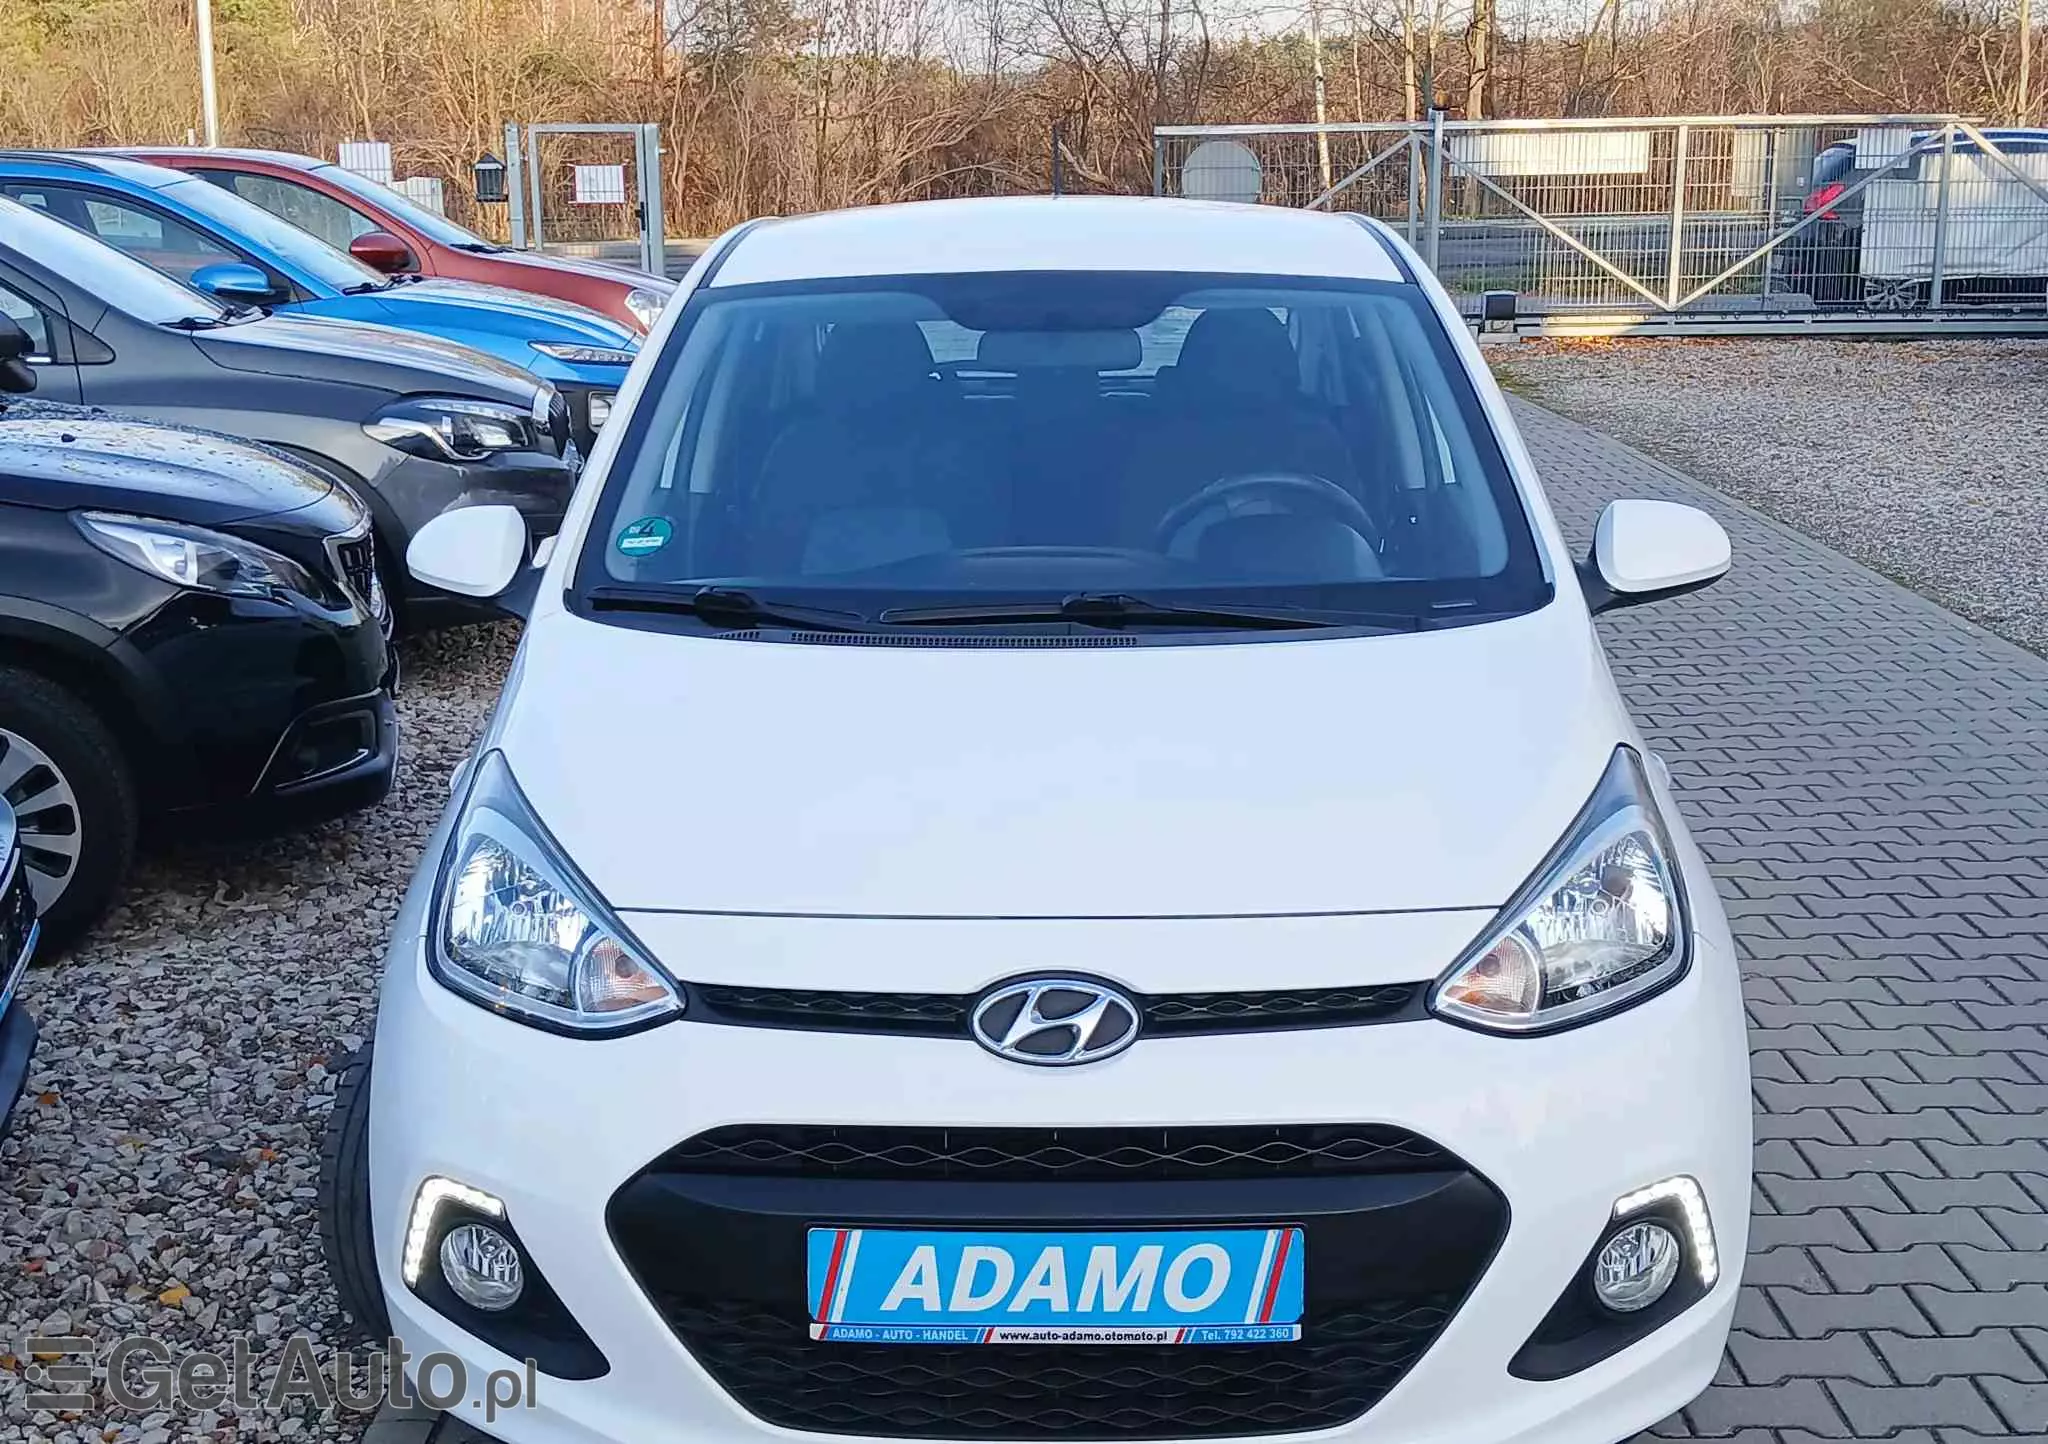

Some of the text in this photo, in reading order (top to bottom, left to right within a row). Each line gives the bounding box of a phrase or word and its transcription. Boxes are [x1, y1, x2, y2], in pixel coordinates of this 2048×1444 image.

[879, 1243, 1231, 1313] ADAMO
[832, 1327, 873, 1340] ADAMO
[882, 1328, 913, 1340] AUTO
[922, 1328, 969, 1341] HANDEL
[1000, 1330, 1168, 1342] www.auto-adamo.otomoto.pl
[1201, 1330, 1220, 1341] Tel.
[1224, 1329, 1245, 1340] 792
[1246, 1328, 1267, 1339] 422
